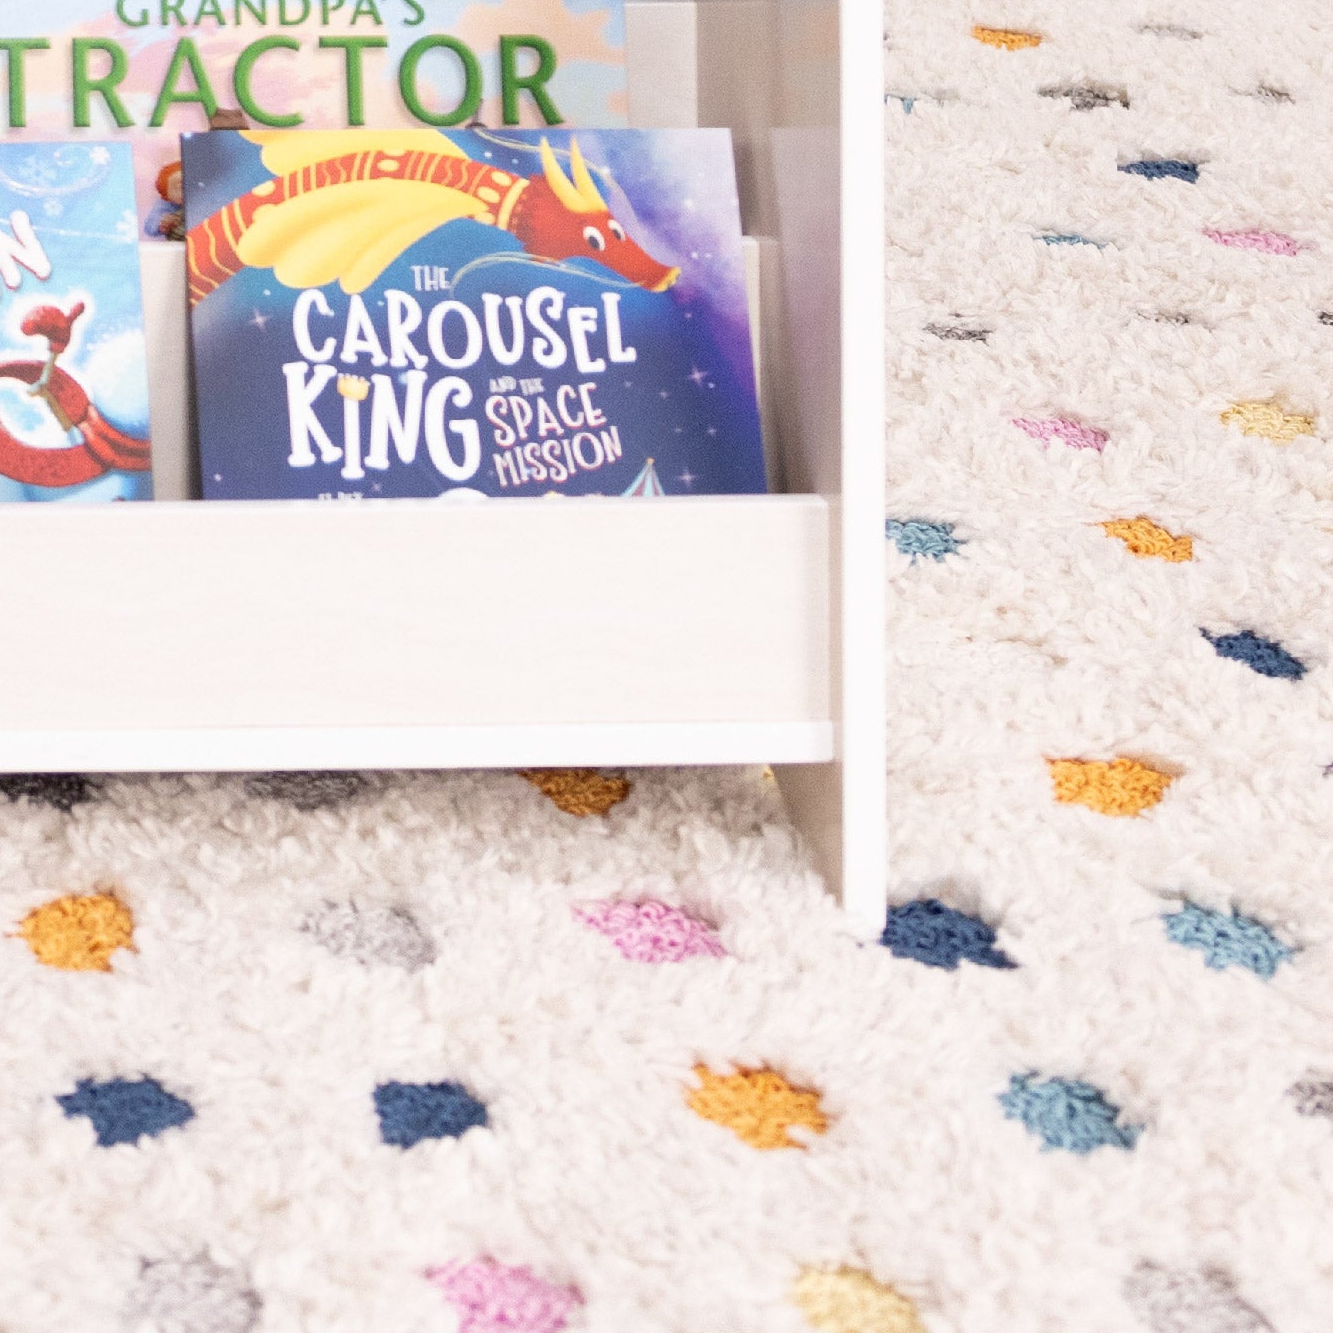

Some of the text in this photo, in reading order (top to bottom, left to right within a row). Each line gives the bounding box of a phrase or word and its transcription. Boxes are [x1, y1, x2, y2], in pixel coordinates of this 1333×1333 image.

[410, 264, 451, 292] THE
[293, 287, 636, 374] CAROUSEL
[282, 361, 481, 481] KING
[485, 381, 608, 448] SPACE
[492, 425, 623, 488] MISSION
